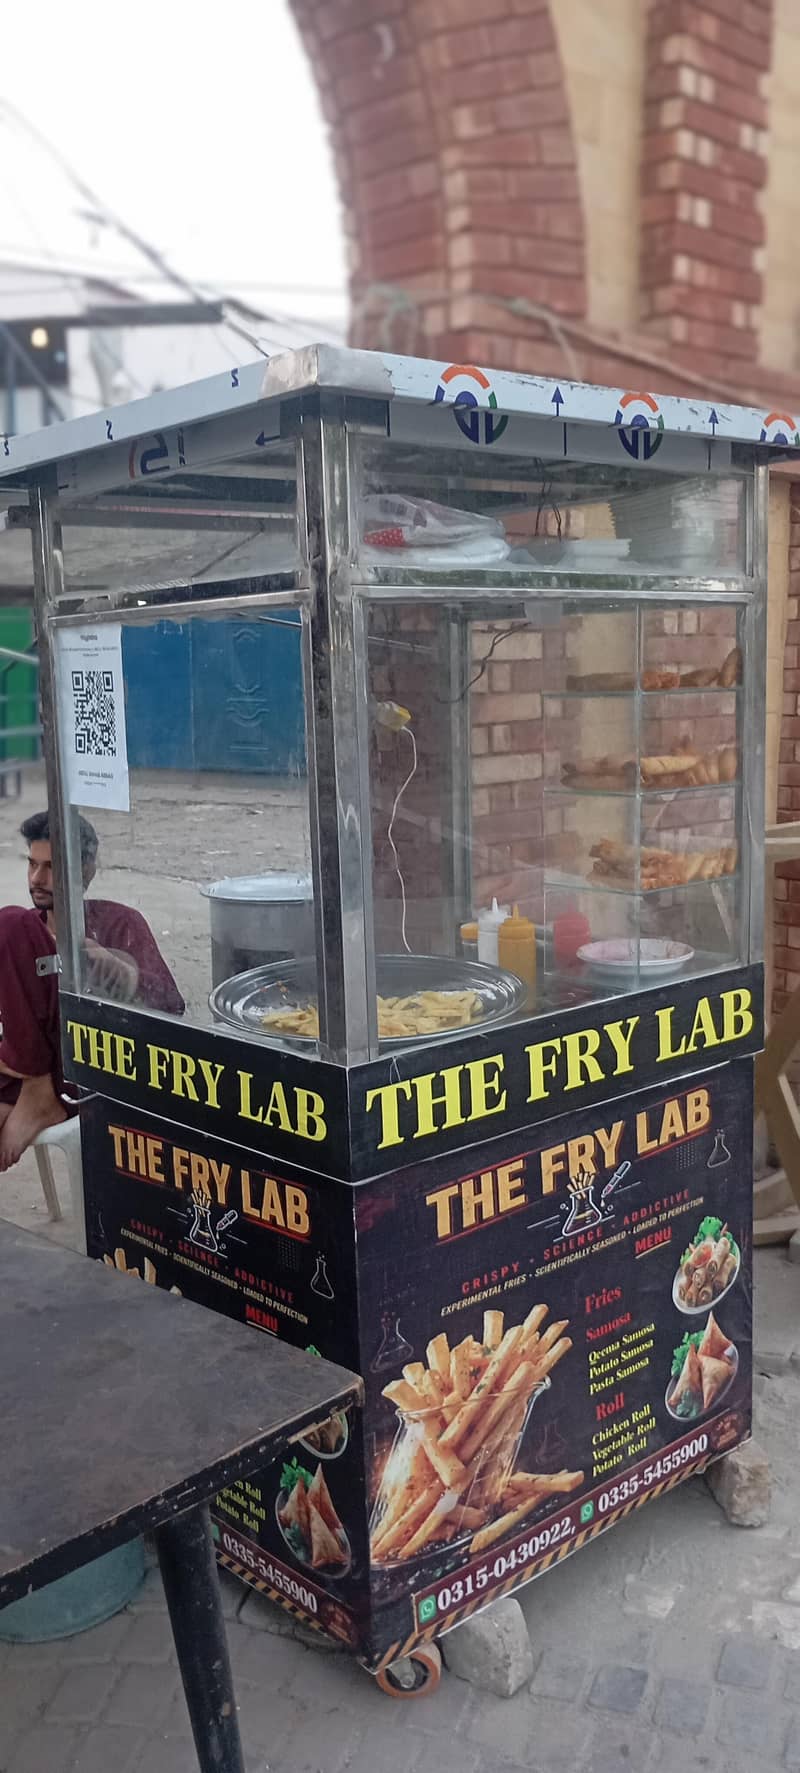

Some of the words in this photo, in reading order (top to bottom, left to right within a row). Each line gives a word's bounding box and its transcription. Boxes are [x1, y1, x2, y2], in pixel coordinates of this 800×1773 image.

[67, 1021, 138, 1081] THE
[146, 1043, 225, 1109] FRY
[236, 1070, 328, 1143] LAB
[366, 1053, 507, 1150] THE
[524, 1016, 639, 1102] FRY
[655, 987, 753, 1063] LAB
[108, 1124, 165, 1183] THE
[172, 1146, 231, 1206] FRY
[241, 1170, 311, 1236] LAB
[425, 1159, 528, 1238] THE
[540, 1120, 626, 1197] FRY
[636, 1088, 711, 1155] LAB
[440, 1282, 502, 1317] EXPERIMENTAL
[504, 1273, 528, 1291] FRIES
[535, 1246, 592, 1277] SCIENTIFICALLY
[590, 1230, 627, 1253] SEASONED
[632, 1217, 658, 1234] LOADED
[658, 1212, 668, 1223] TO
[666, 1196, 705, 1219] PERFECTION
[461, 1261, 521, 1294] CRISPY
[543, 1226, 604, 1260] SCIENCE
[623, 1189, 690, 1226] ADDICTIVE
[634, 1226, 673, 1254] MENU
[234, 1266, 294, 1303] ADDICTIVE
[585, 1287, 622, 1313] Fries
[243, 1286, 265, 1303] LOADED
[265, 1296, 273, 1308] TO
[273, 1300, 309, 1325] PERFECTION
[245, 1303, 279, 1332] MENU
[586, 1311, 632, 1341] Samosa
[588, 1340, 621, 1365] Qeema
[621, 1322, 656, 1345] Samosa
[589, 1357, 620, 1379] Potato
[620, 1339, 654, 1362] Samosa
[589, 1375, 615, 1396] Pasta
[615, 1356, 650, 1381] Samosa
[592, 1418, 631, 1446] Chicken
[631, 1403, 652, 1424] Roll
[595, 1391, 626, 1421] Roll
[592, 1431, 635, 1461] Vegetable
[637, 1416, 657, 1436] Roll
[592, 1454, 624, 1478] Potato
[627, 1436, 648, 1456] Roll
[245, 1481, 262, 1502] Roll
[249, 1500, 266, 1521] Roll
[216, 1494, 240, 1520] Potato
[242, 1512, 260, 1533] Roll
[437, 1515, 576, 1612] 0315-0430922,
[598, 1433, 709, 1514] 0335-5455900
[223, 1532, 319, 1614] 0335-5455900
